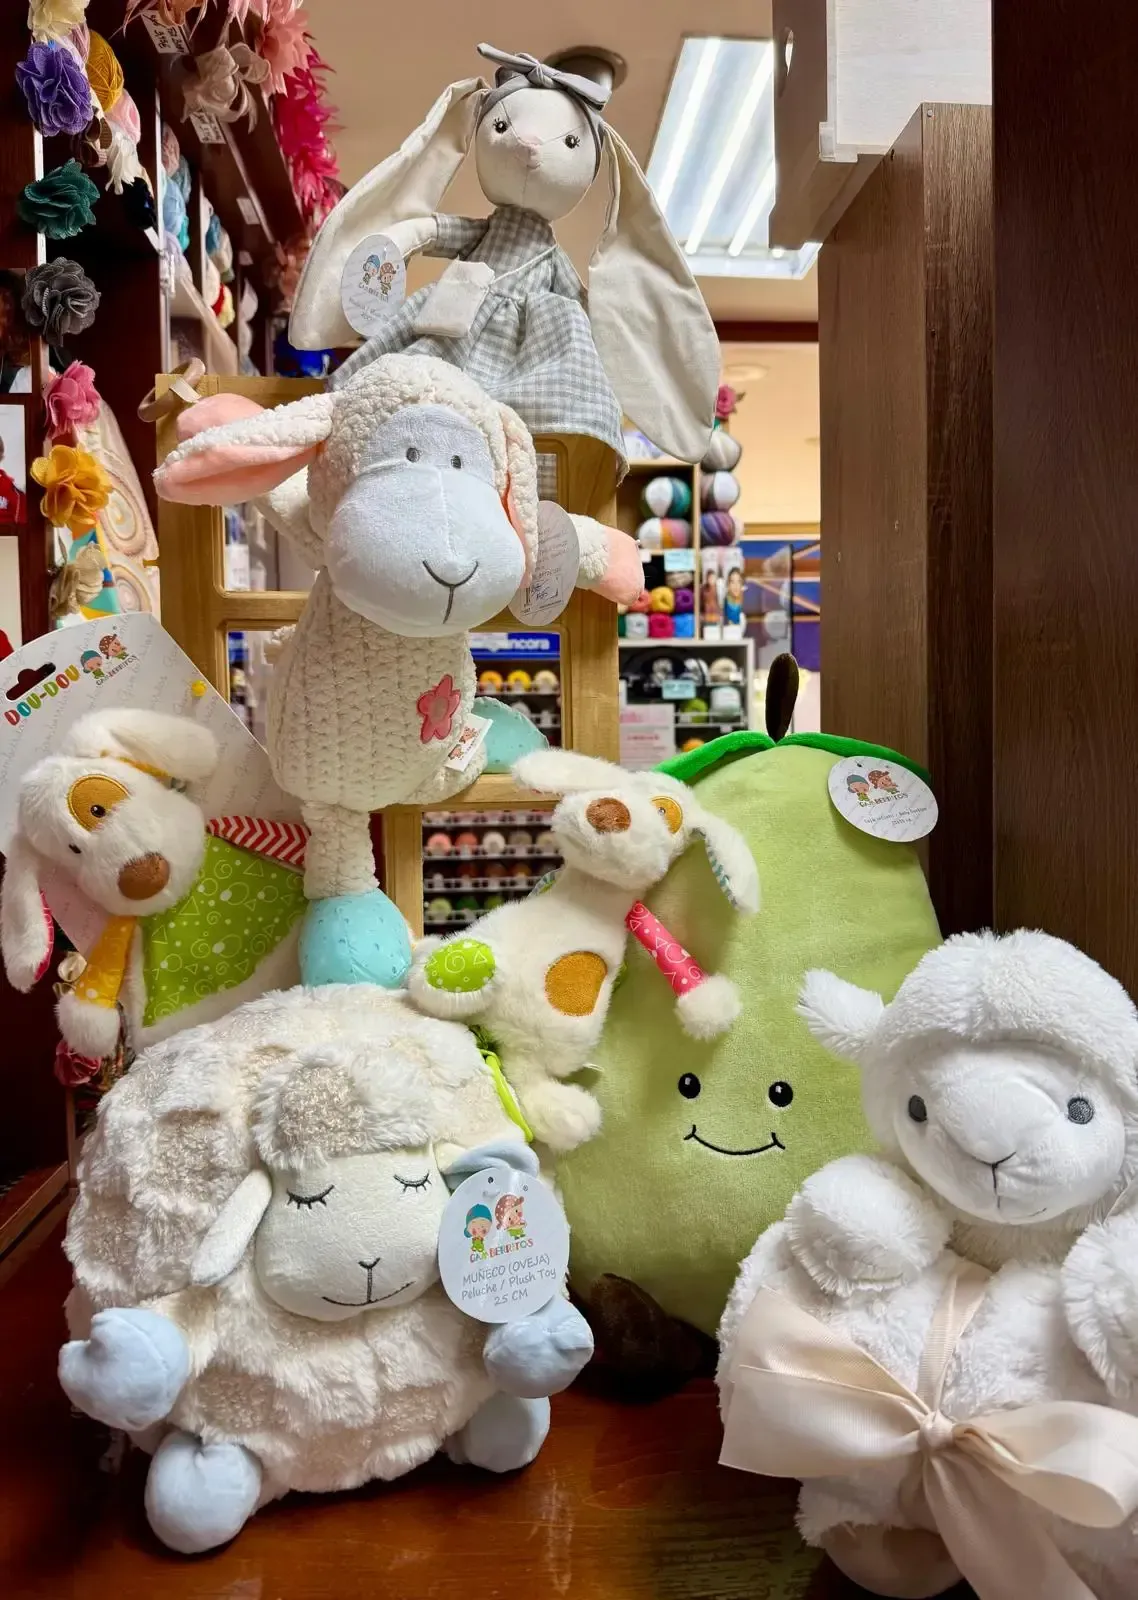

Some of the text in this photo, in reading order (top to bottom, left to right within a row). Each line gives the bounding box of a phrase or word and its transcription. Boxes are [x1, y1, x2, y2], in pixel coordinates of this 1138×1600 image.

[4, 664, 80, 726] DOU-DOU
[461, 1268, 557, 1300] Peluche / Plush Toy
[462, 1253, 551, 1286] MUÑECO (OVEJA)
[494, 1288, 528, 1306] 25 CM
